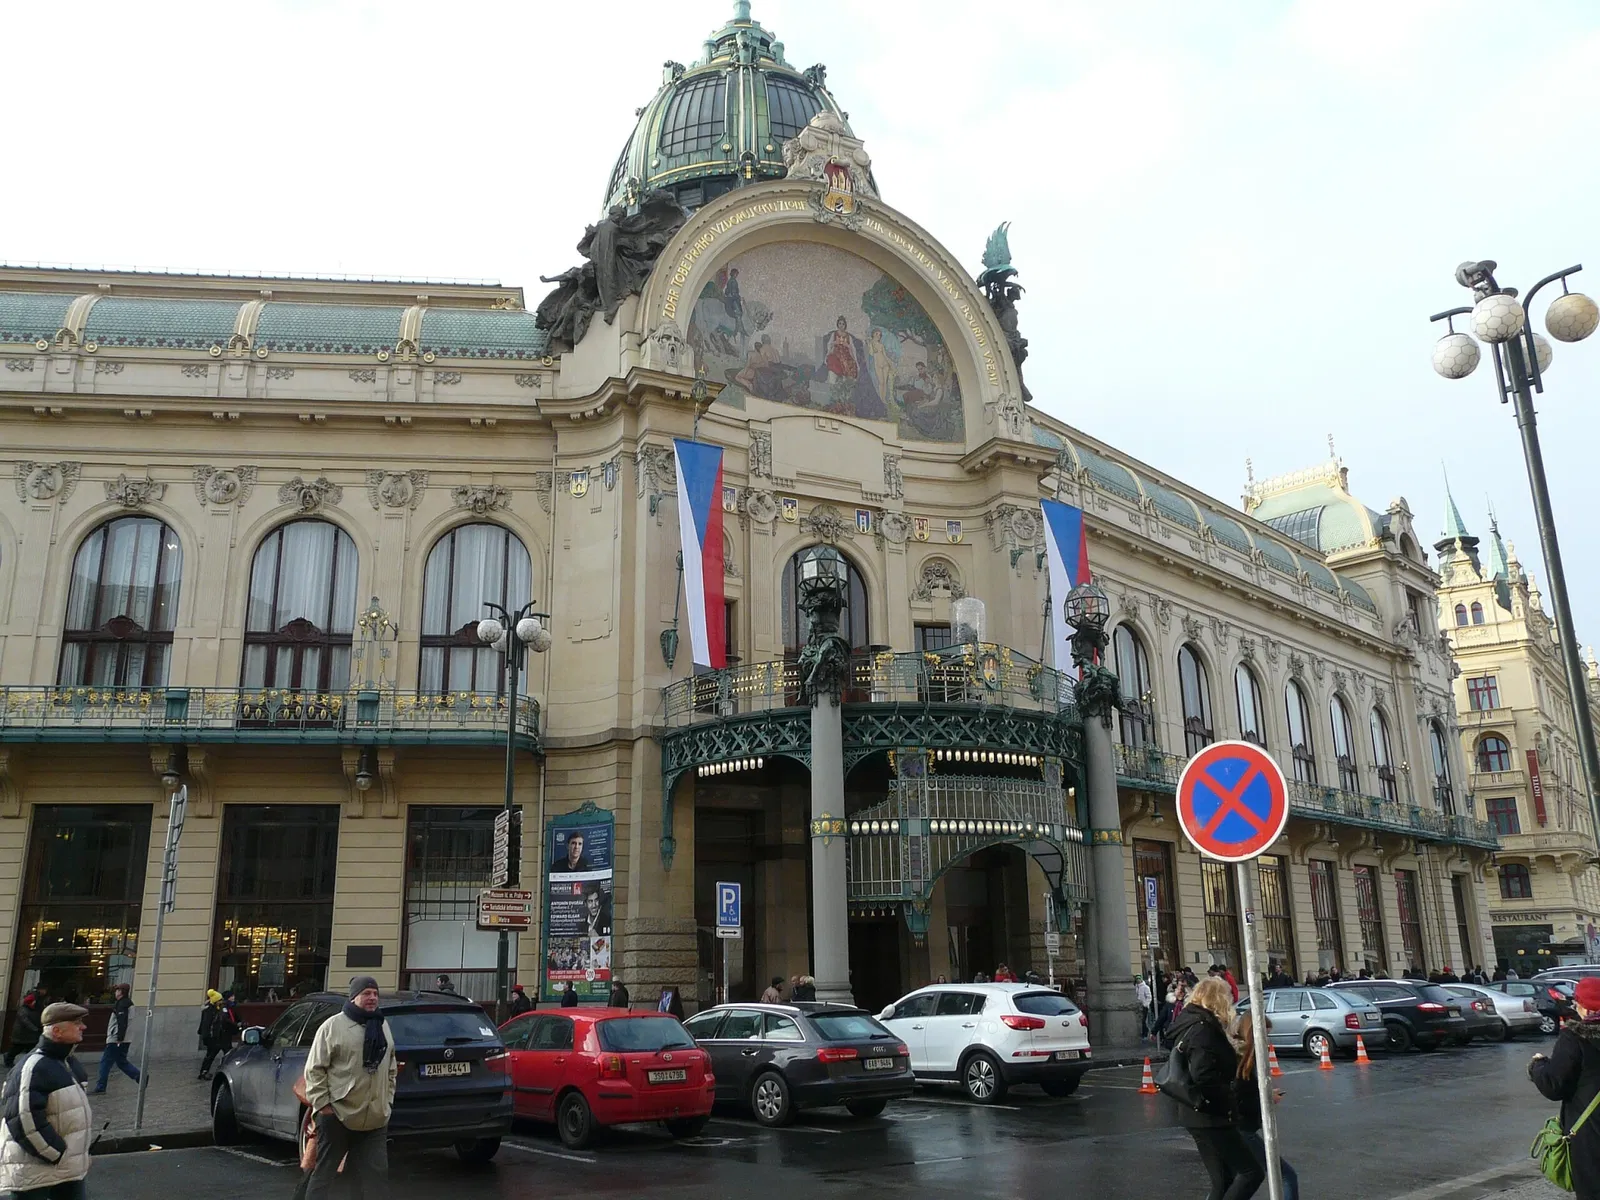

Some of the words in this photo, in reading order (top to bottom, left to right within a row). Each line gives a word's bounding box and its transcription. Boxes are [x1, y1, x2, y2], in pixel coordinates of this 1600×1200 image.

[663, 288, 680, 320] ZDAR
[1532, 775, 1541, 797] HOTEL
[722, 888, 736, 913] P
[1148, 881, 1155, 900] P
[1491, 913, 1549, 923] RESTAURANT
[447, 1063, 467, 1073] 8441
